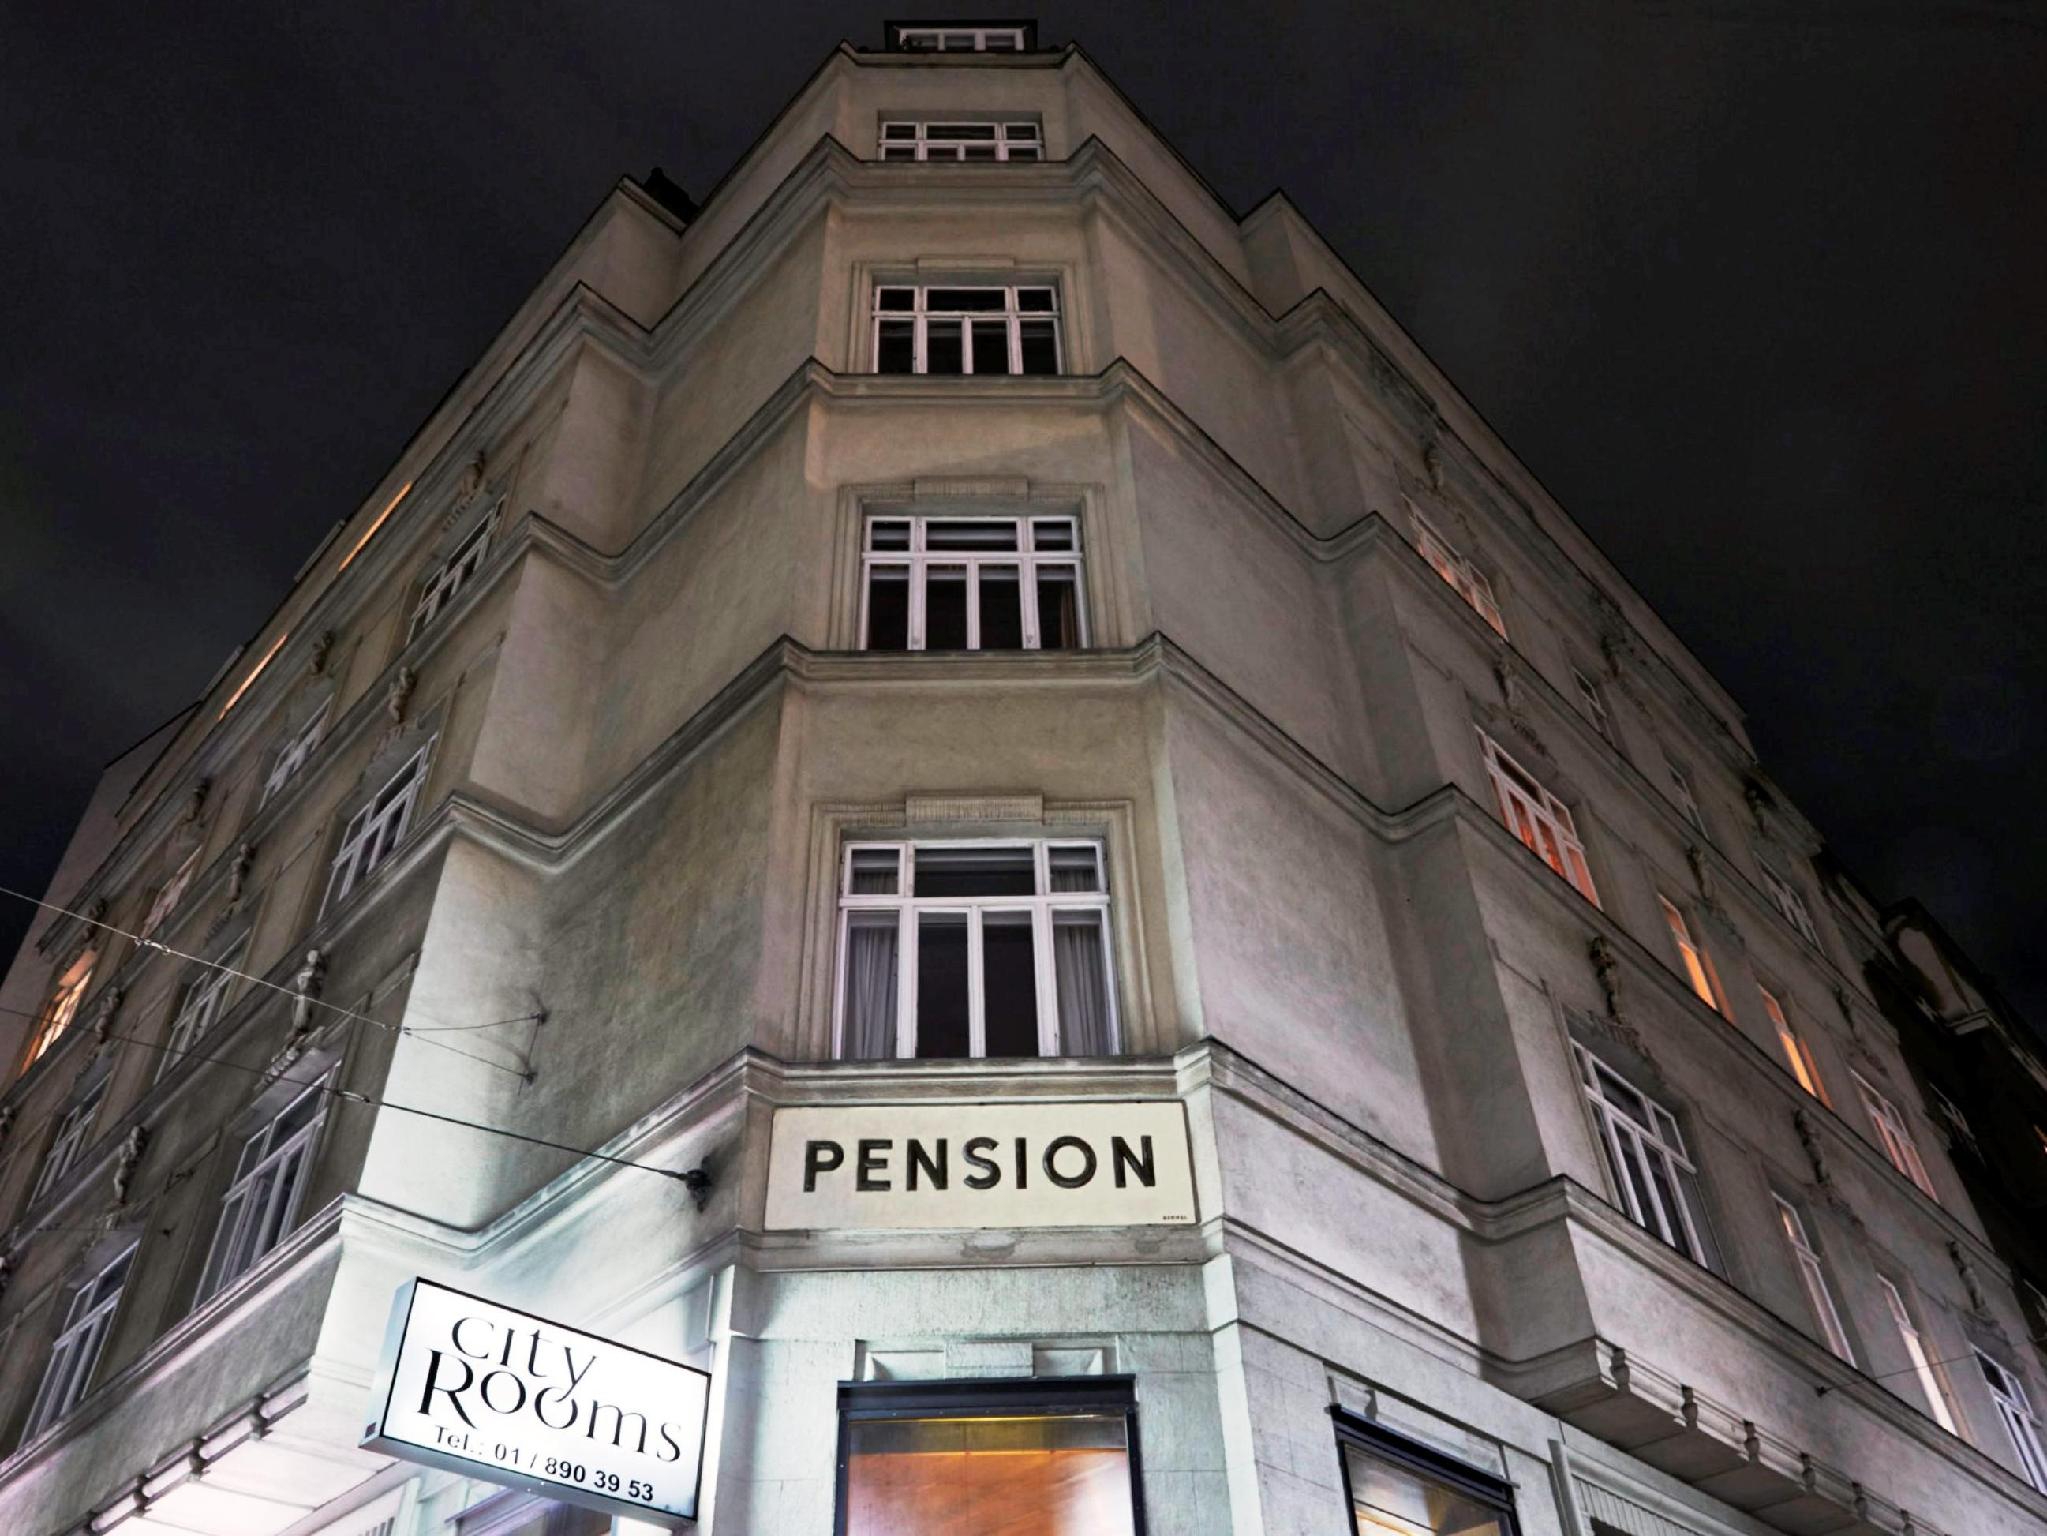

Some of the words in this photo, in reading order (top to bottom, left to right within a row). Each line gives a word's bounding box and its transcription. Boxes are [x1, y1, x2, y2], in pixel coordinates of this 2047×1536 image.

[803, 1135, 1156, 1192] PENSION
[495, 1443, 520, 1465] 01
[545, 1457, 586, 1483] 890
[594, 1470, 620, 1492] 39
[628, 1480, 654, 1502] 53
